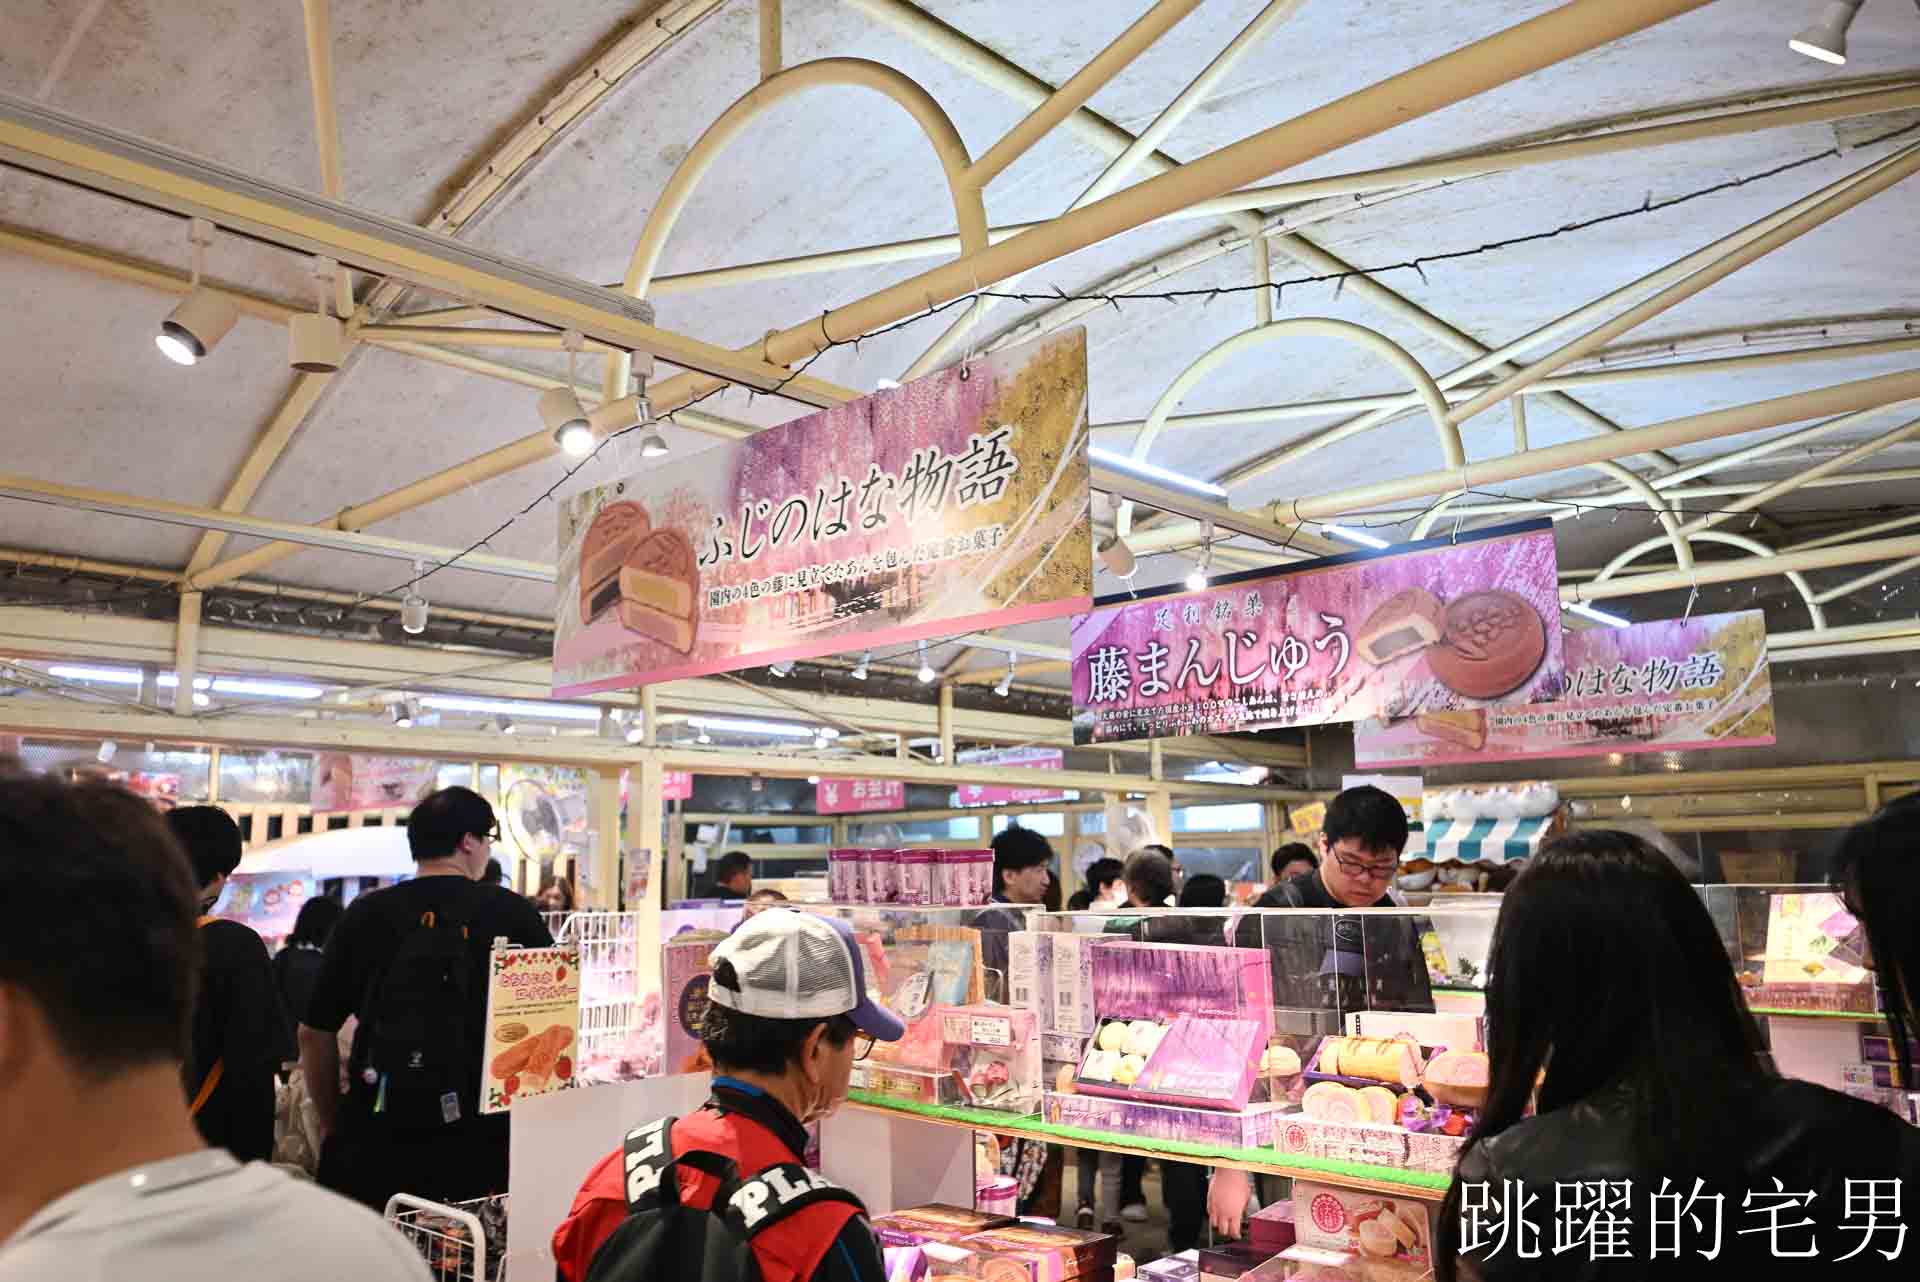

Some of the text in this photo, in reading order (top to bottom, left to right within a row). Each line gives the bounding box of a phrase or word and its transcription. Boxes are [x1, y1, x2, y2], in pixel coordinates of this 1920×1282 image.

[699, 431, 1017, 566] ふじのはな物語
[1153, 591, 1264, 630] 足利銘菓
[1087, 612, 1351, 704] 藤まんじゅう
